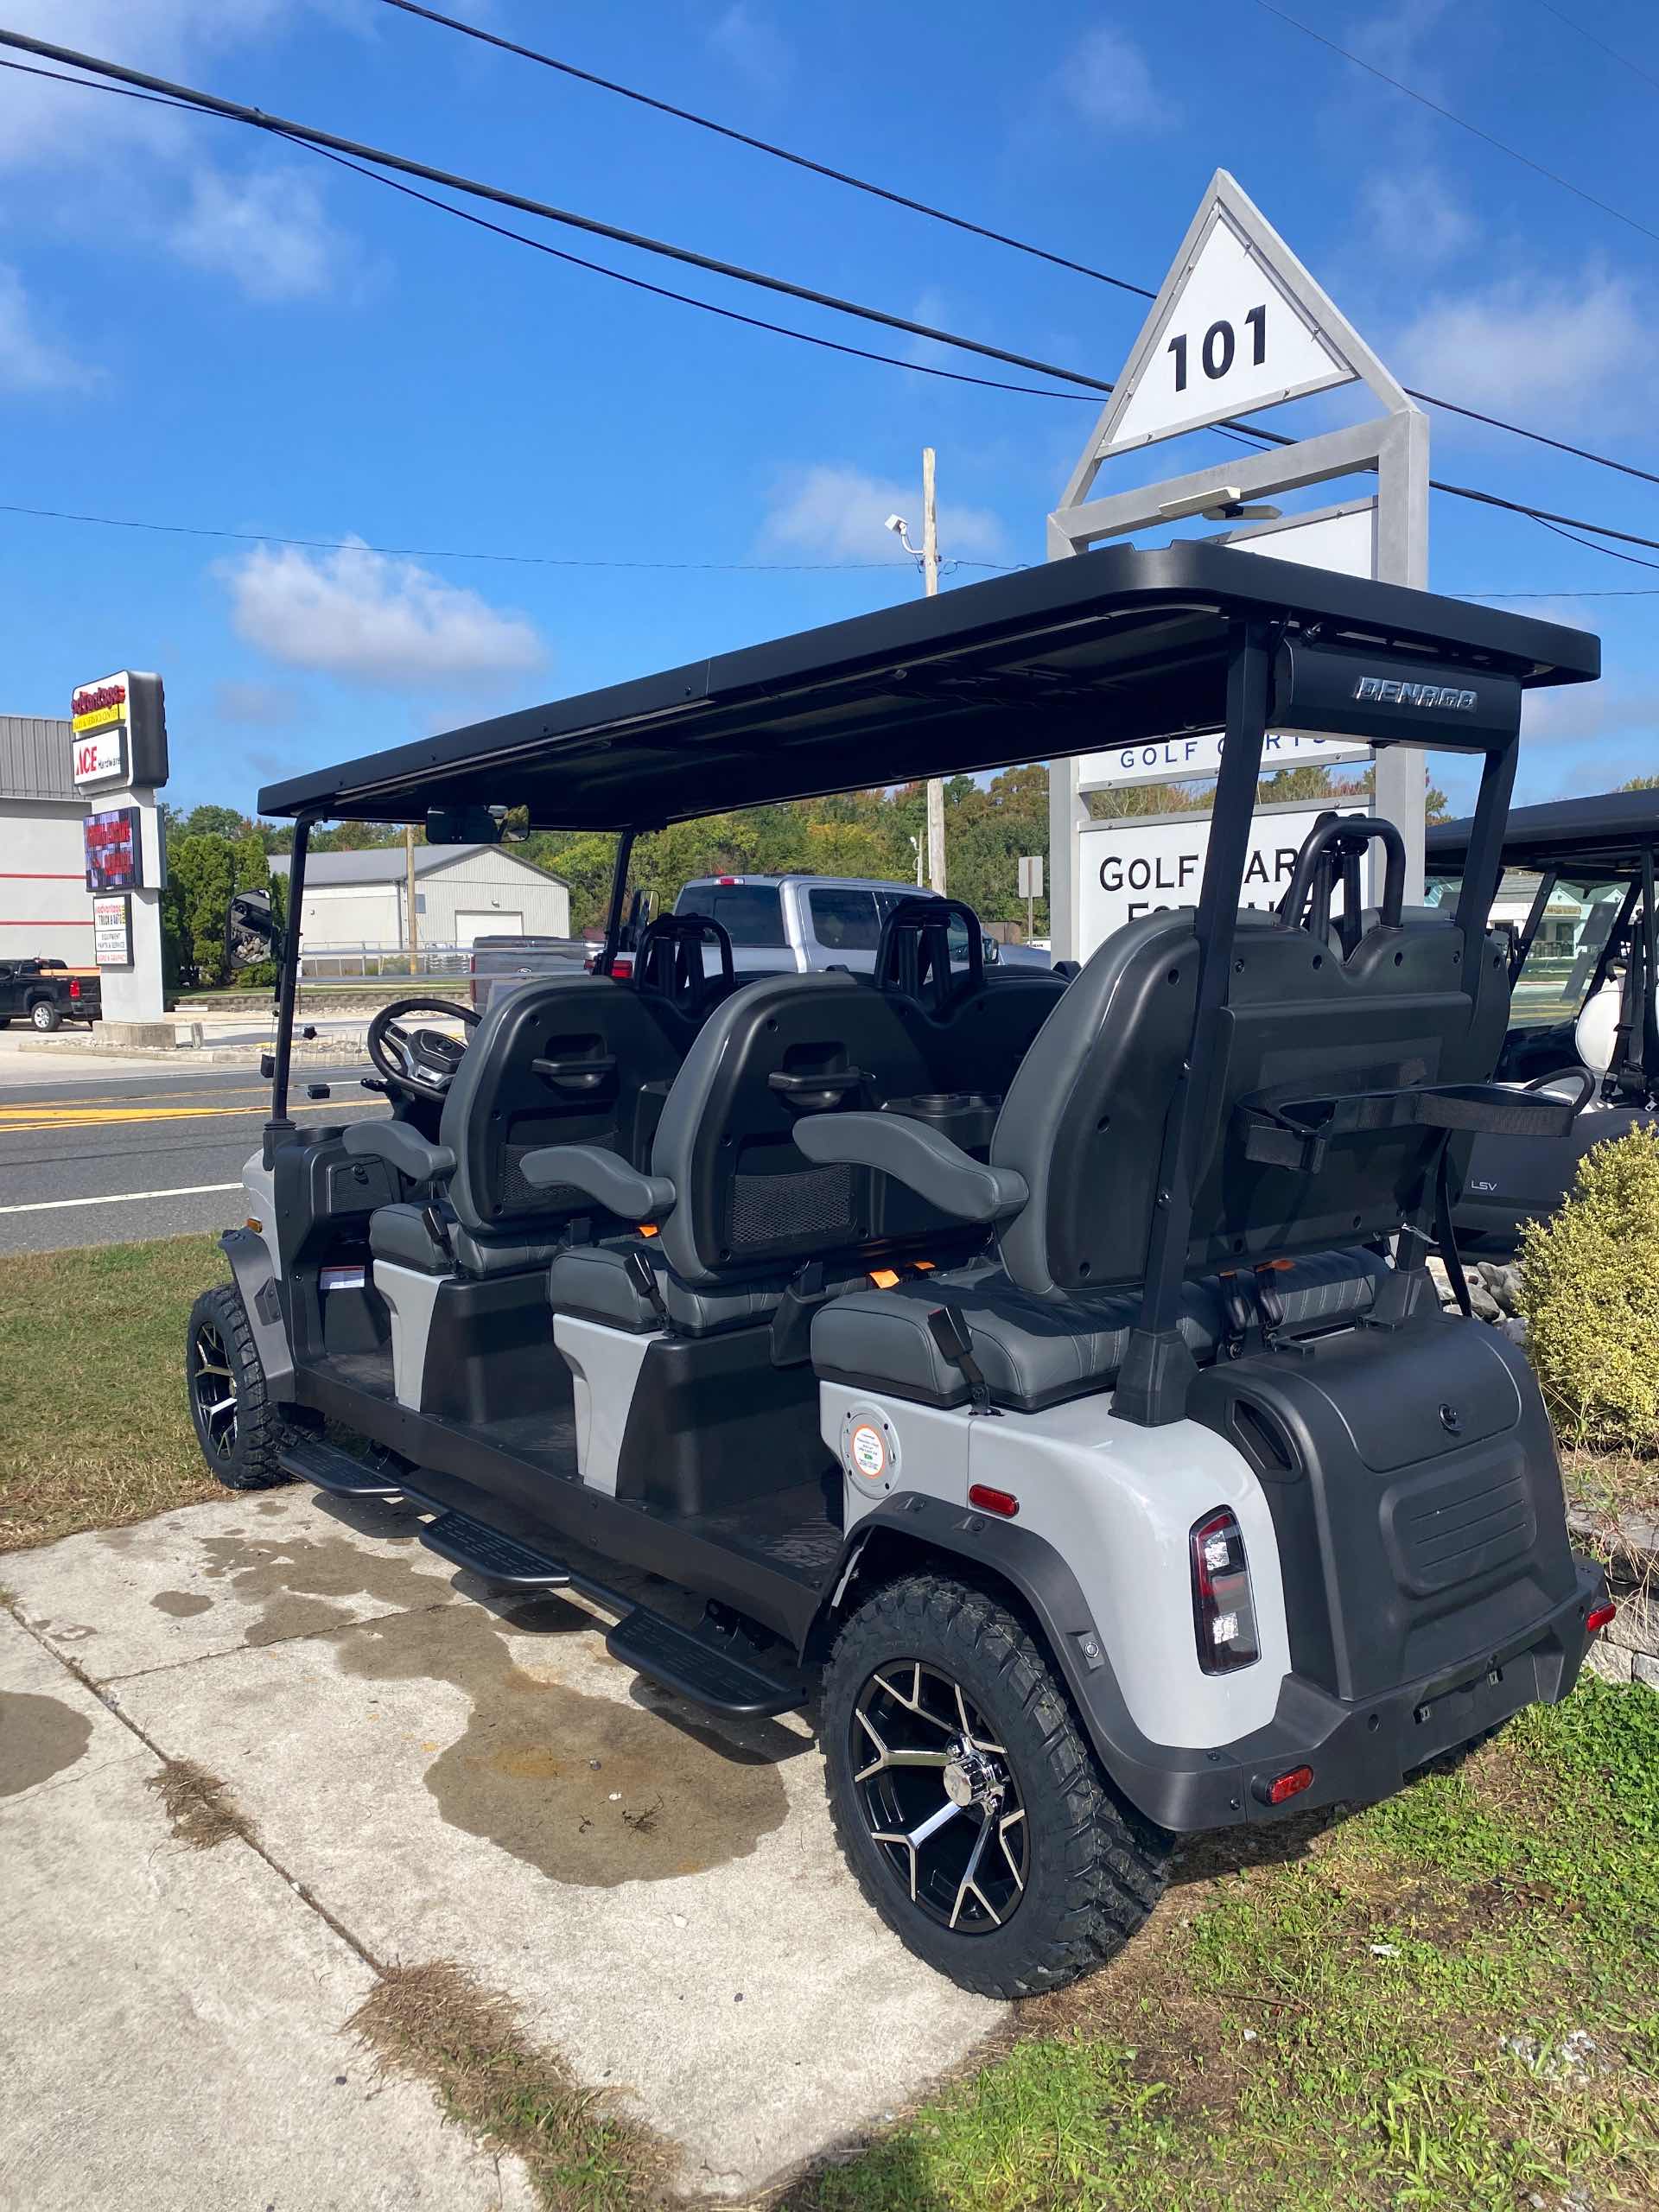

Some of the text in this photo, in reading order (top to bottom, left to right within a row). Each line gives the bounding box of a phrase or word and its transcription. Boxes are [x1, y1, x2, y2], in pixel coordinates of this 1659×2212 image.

[1167, 304, 1267, 392] 101
[1355, 676, 1478, 711] DENAGO
[76, 746, 97, 776] ACE
[1121, 741, 1198, 768] GOLF
[1099, 854, 1199, 892] GOLF
[1471, 1179, 1497, 1192] LSV
